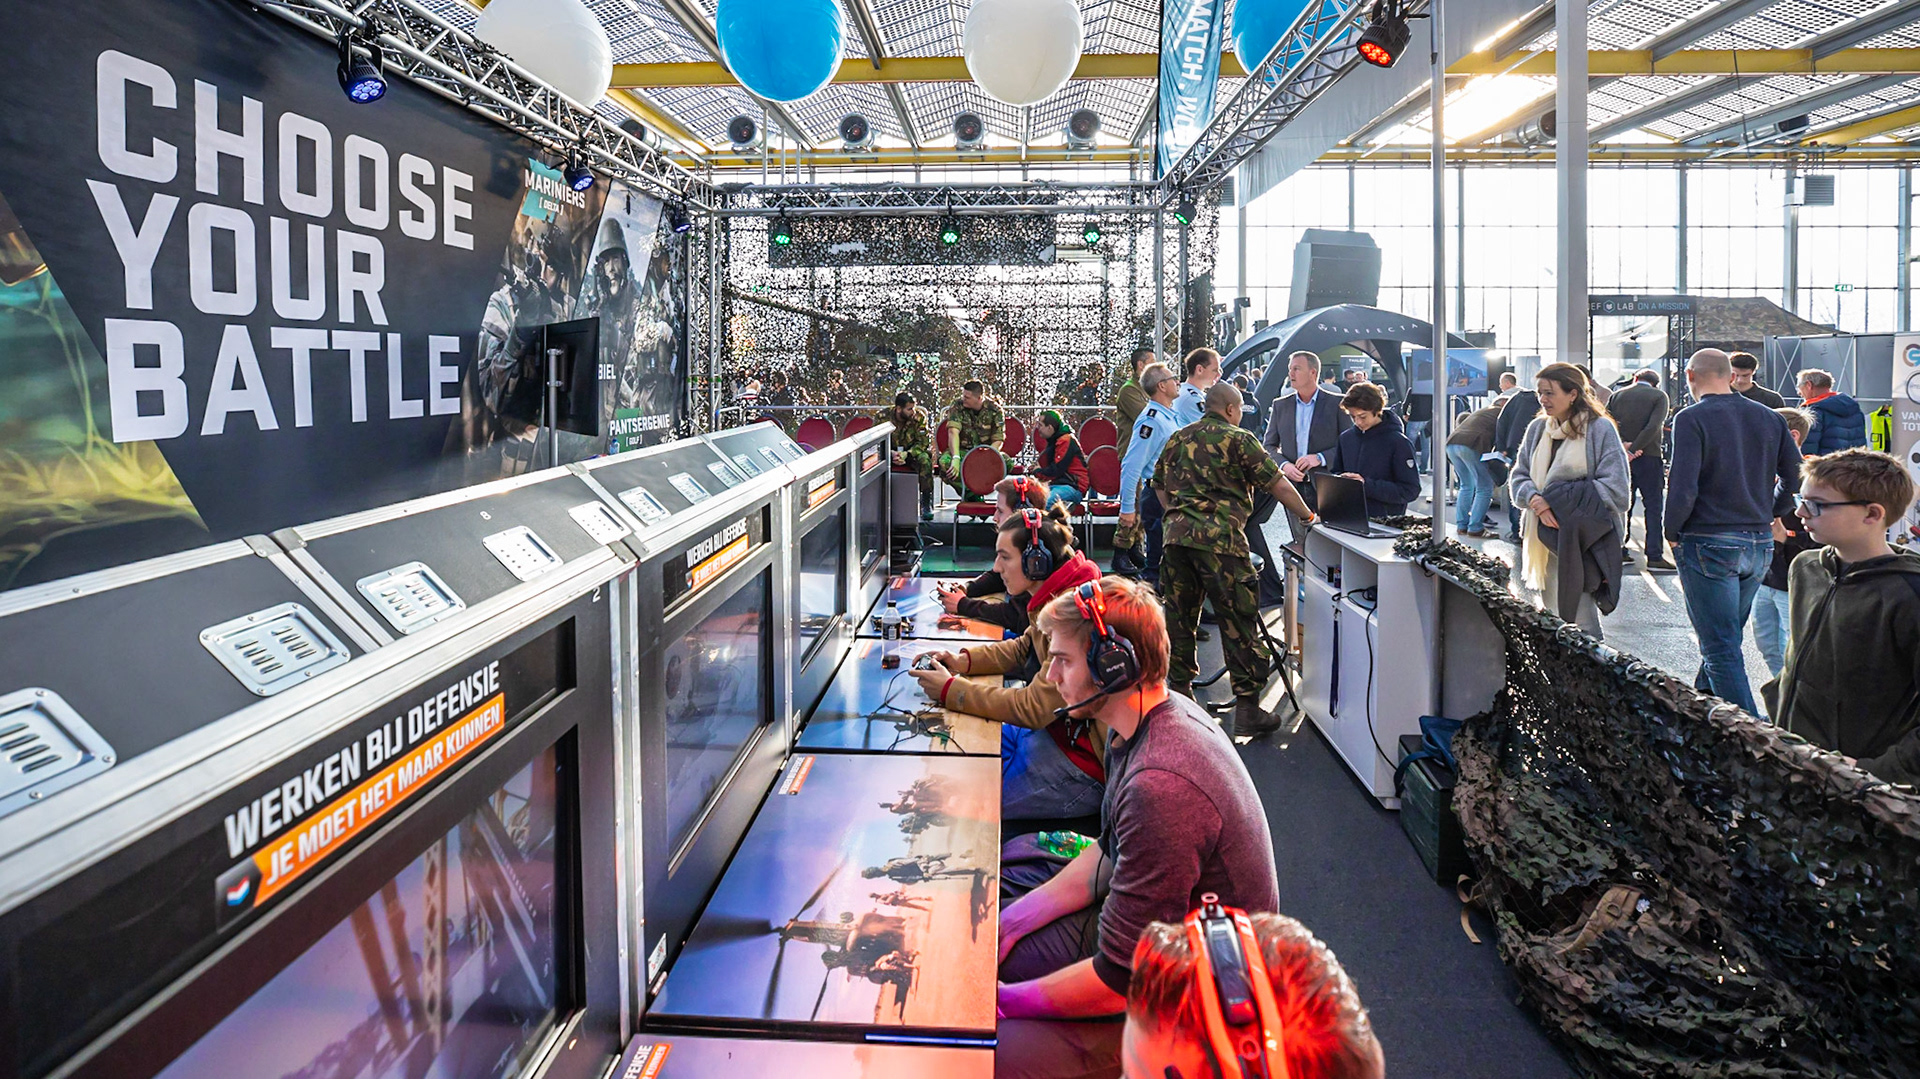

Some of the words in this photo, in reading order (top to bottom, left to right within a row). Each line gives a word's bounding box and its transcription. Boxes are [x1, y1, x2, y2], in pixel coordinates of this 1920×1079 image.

[95, 48, 474, 251] CHOOSE
[524, 168, 586, 210] MARINIERS
[85, 178, 390, 325] YOUR
[1616, 302, 1634, 311] LAB
[1637, 302, 1649, 310] ON
[1650, 302, 1657, 310] A
[1658, 302, 1690, 310] MISSION
[104, 317, 461, 443] BATTLE
[597, 363, 617, 380] BIEL
[609, 413, 671, 437] PANTSERGENIE
[592, 586, 601, 603] 2
[223, 740, 362, 859] WERKEN
[366, 715, 404, 771] BIJ
[407, 659, 500, 744] DEFENSIE
[265, 841, 295, 886] JE
[298, 798, 358, 863] MOET
[360, 772, 396, 819] HET
[397, 740, 443, 793] MAAR
[445, 702, 501, 757] KUNNEN
